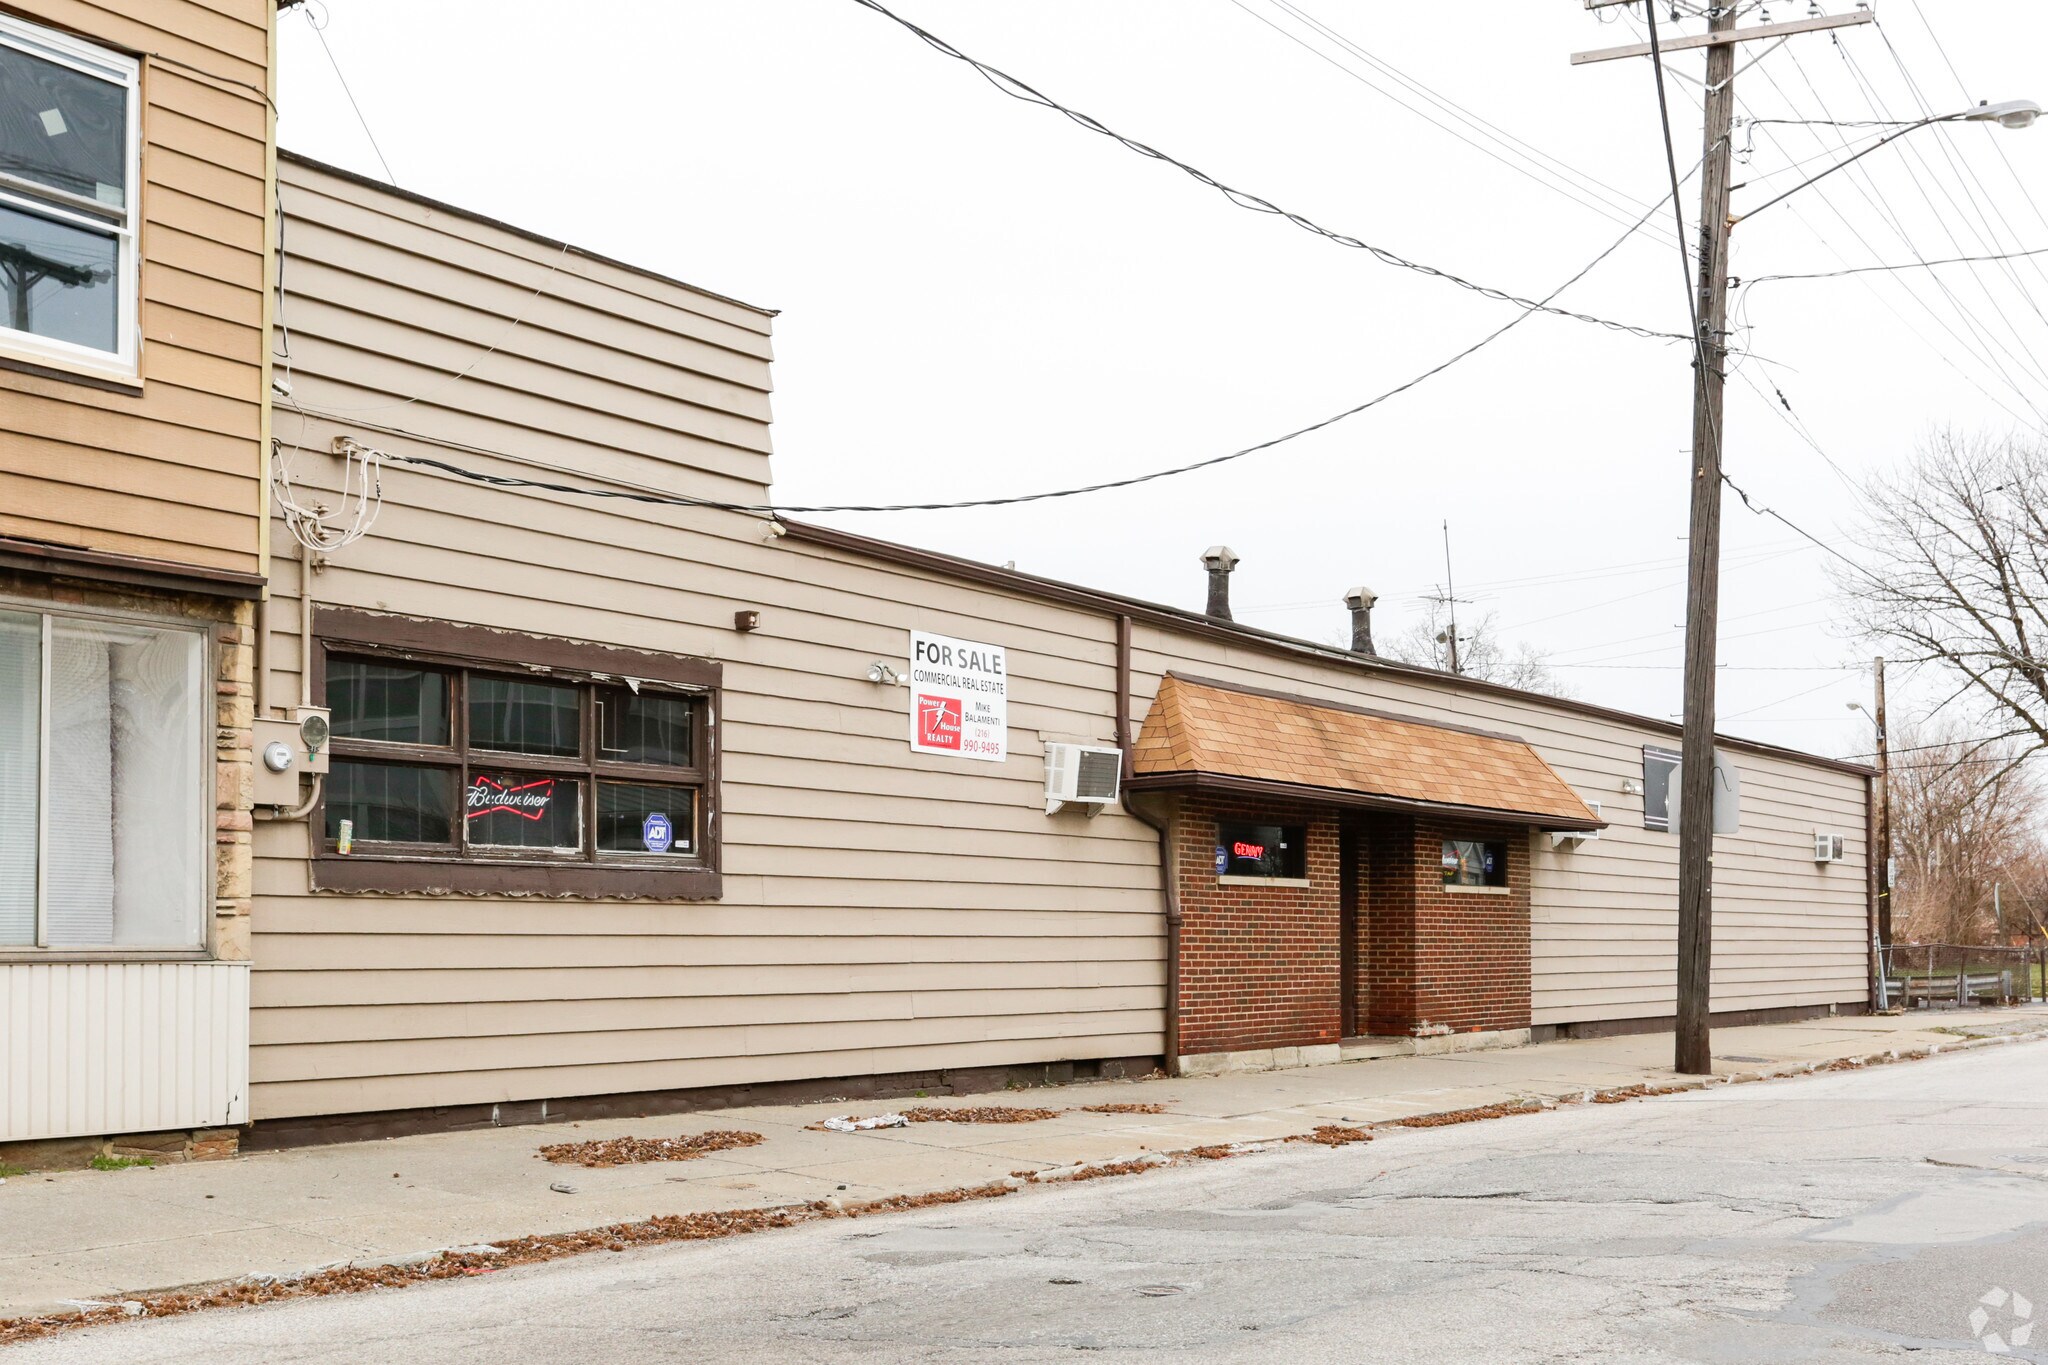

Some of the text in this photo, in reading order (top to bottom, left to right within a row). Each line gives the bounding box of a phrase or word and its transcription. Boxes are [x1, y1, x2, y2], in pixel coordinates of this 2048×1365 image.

[916, 640, 1002, 675] FOR SALE
[914, 669, 1004, 695] COMMERCIAL REAL ESTATE
[919, 696, 940, 707] Power
[964, 711, 1000, 726] BALAMENTI
[940, 721, 961, 733] House
[975, 727, 990, 739] (216)
[927, 732, 953, 743] REALTY
[963, 739, 1000, 755] 990-9495
[466, 786, 550, 807] Budweiser
[648, 826, 666, 840] ADT
[1234, 842, 1264, 858] GENNY
